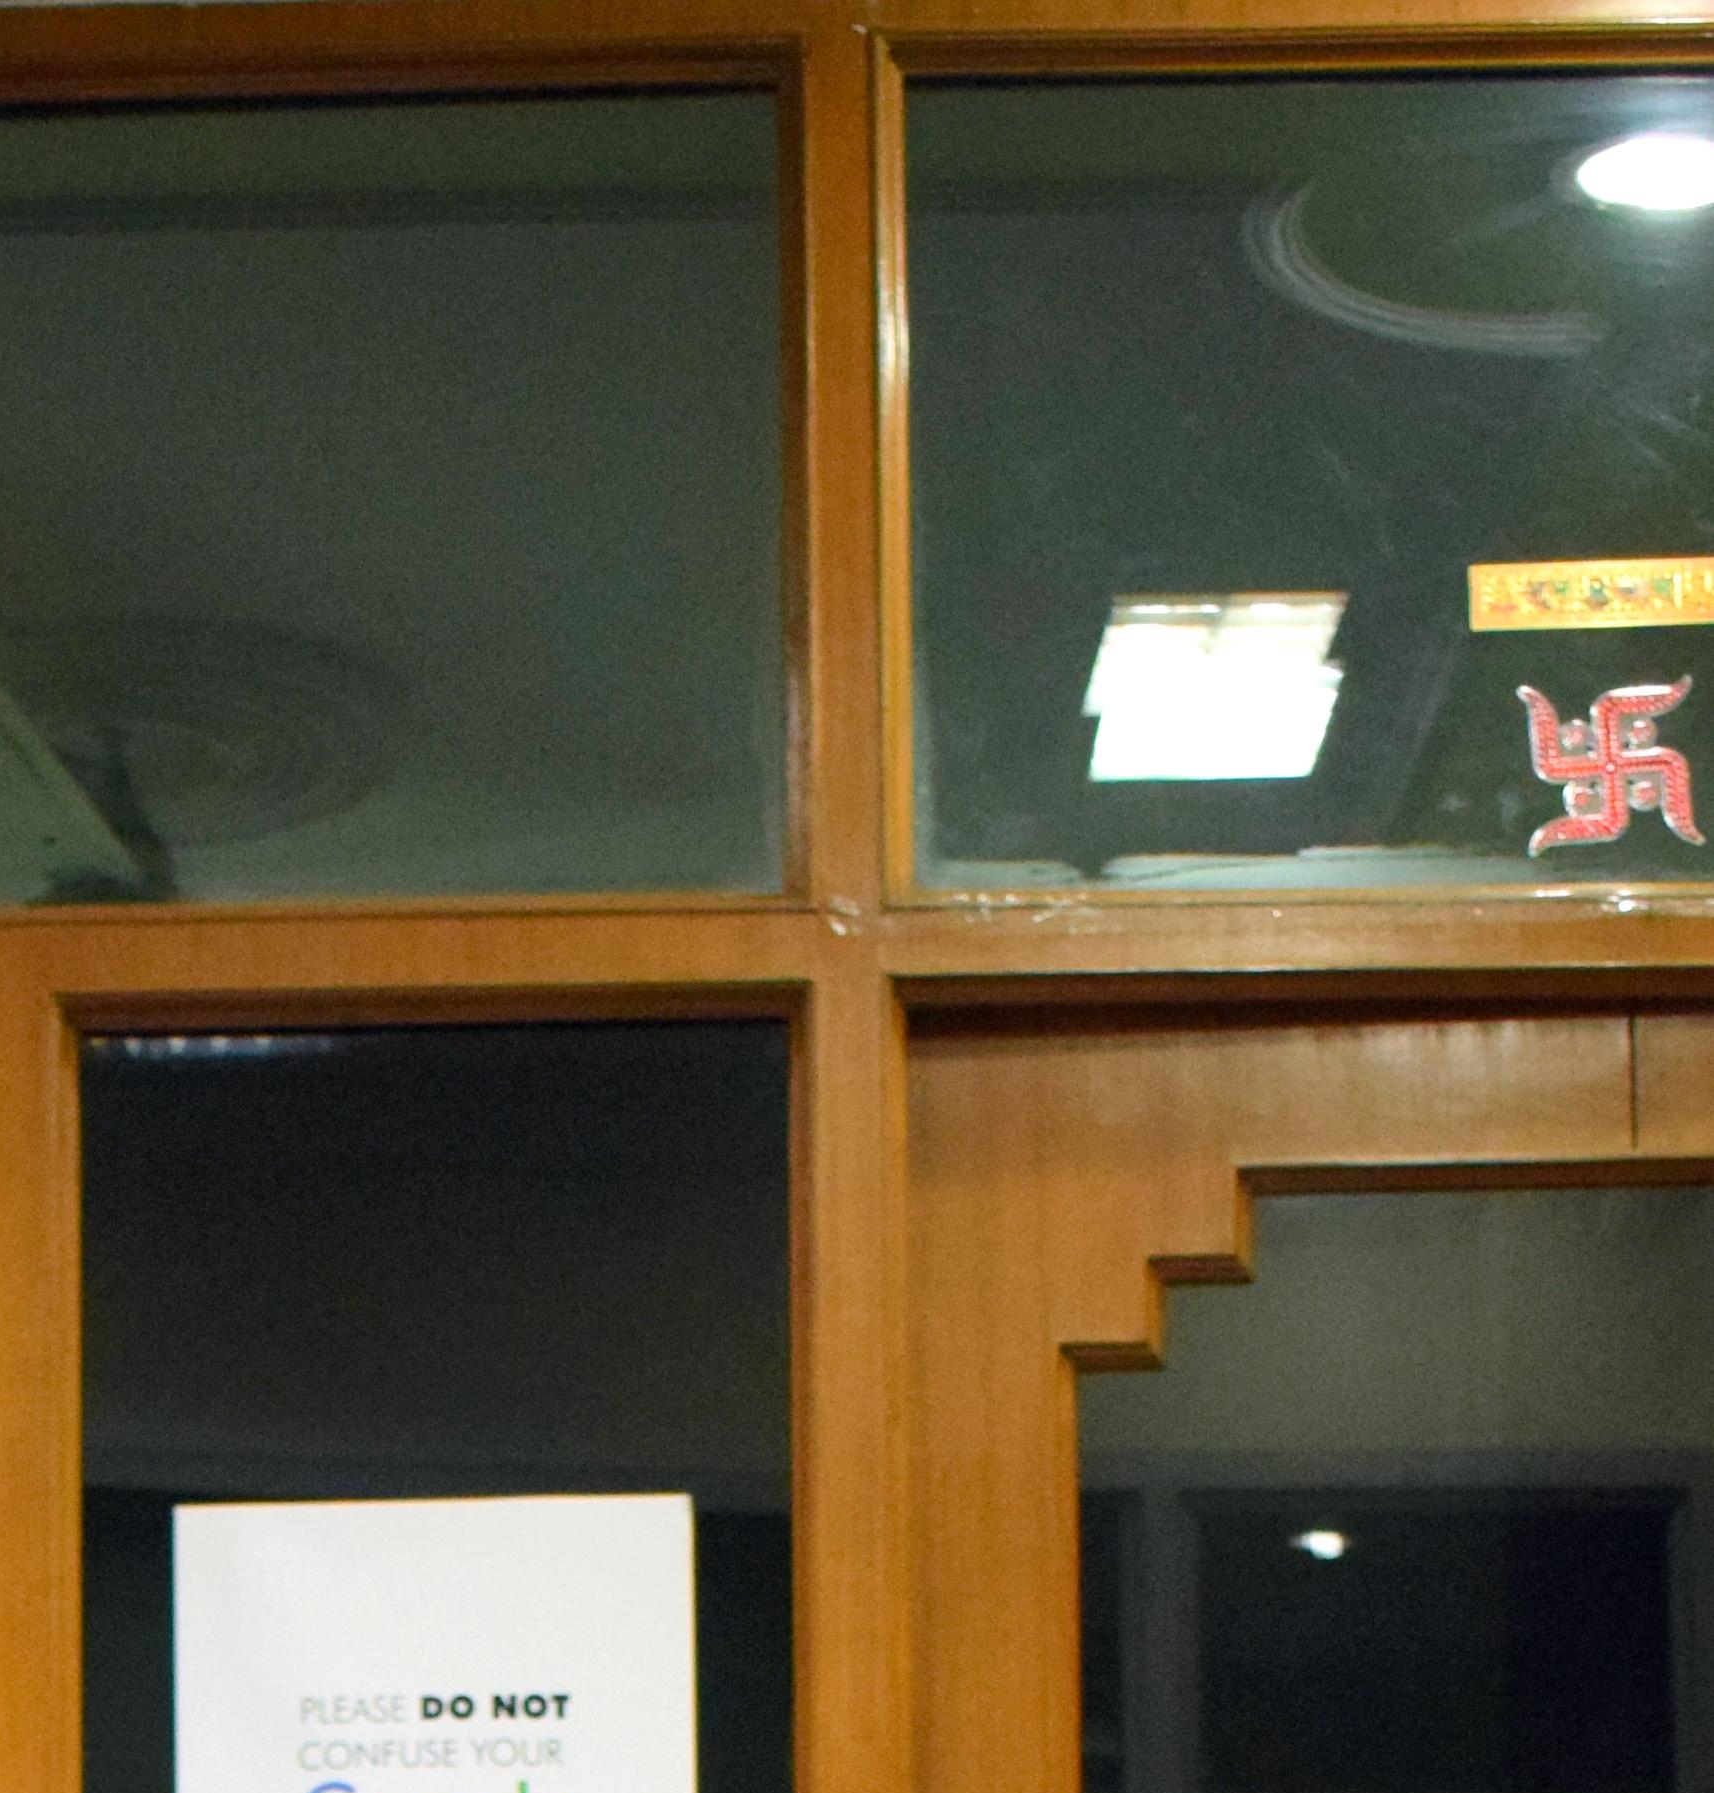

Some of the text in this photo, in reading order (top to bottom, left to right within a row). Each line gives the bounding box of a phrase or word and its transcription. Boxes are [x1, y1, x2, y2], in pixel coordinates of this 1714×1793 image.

[298, 1693, 571, 1725] PLEASE DO NOT
[296, 1737, 564, 1771] CONFUSE YOUR
